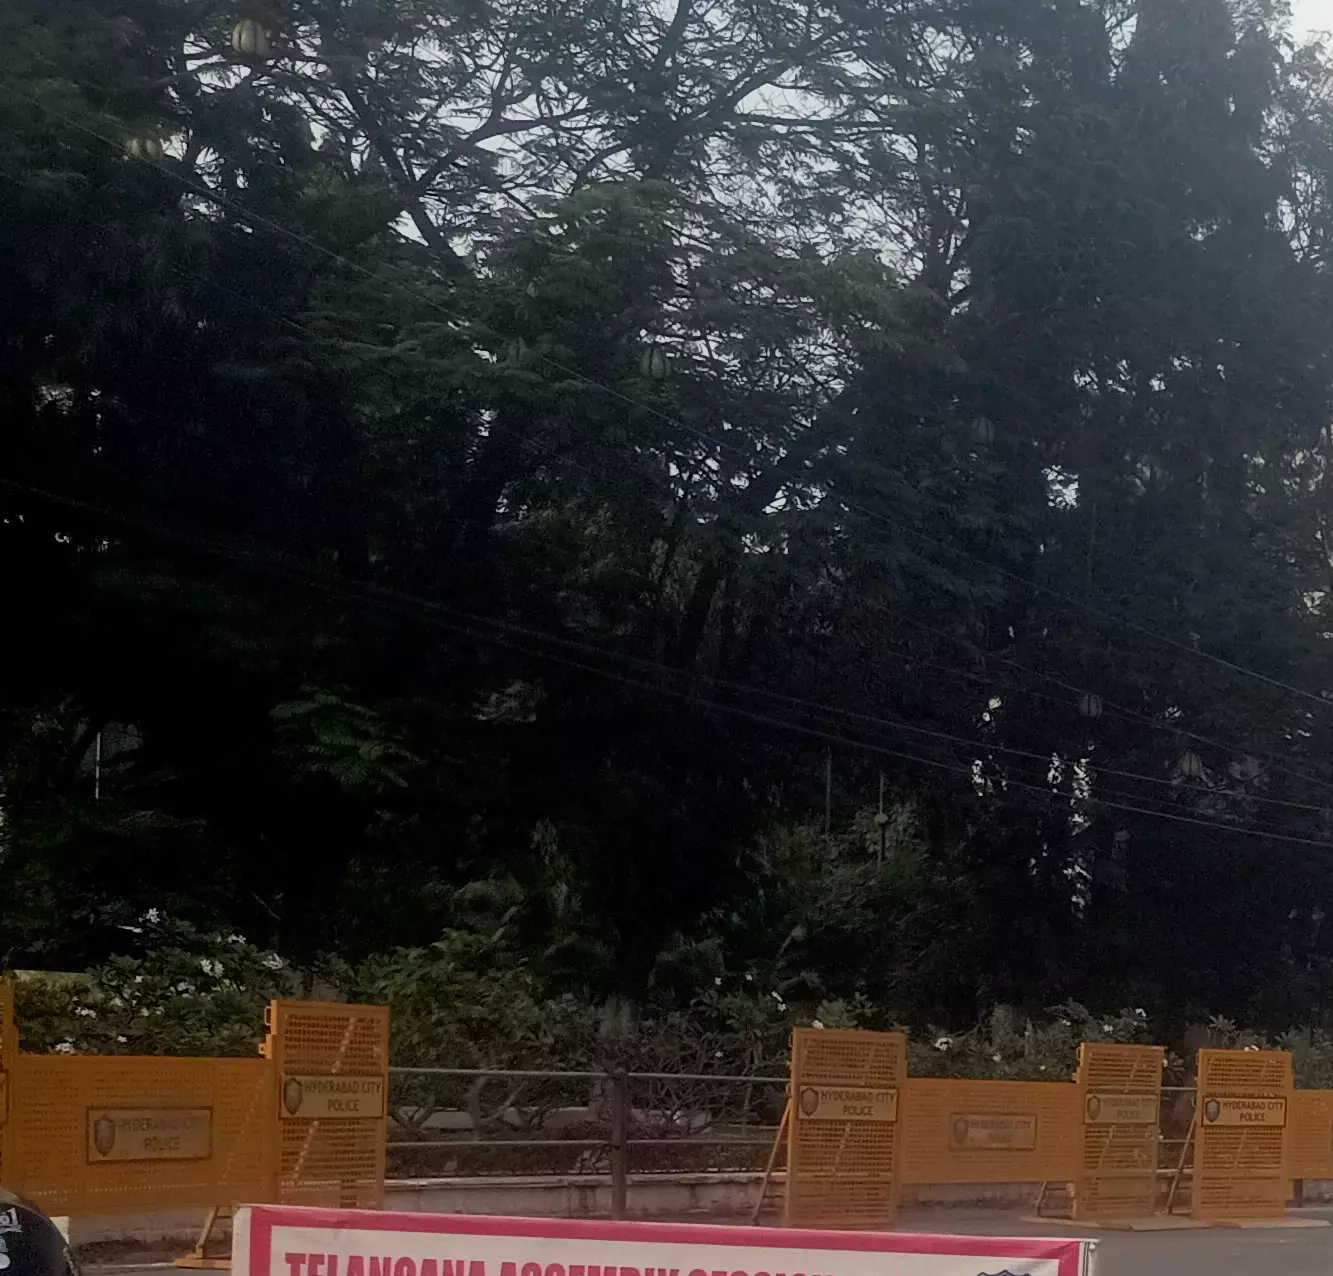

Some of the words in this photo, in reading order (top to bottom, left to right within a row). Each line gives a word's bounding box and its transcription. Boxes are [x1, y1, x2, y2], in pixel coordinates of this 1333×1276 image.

[304, 1080, 358, 1095] HYDERABAD
[361, 1080, 381, 1093] CITY
[820, 1089, 873, 1103] HYDERABAD
[875, 1092, 895, 1103] CITY
[327, 1098, 360, 1112] POLICE
[842, 1104, 874, 1117] POLICE
[1222, 1100, 1266, 1112] HYDERABAD
[1268, 1101, 1284, 1112] CITY
[1240, 1111, 1265, 1123] POLICE
